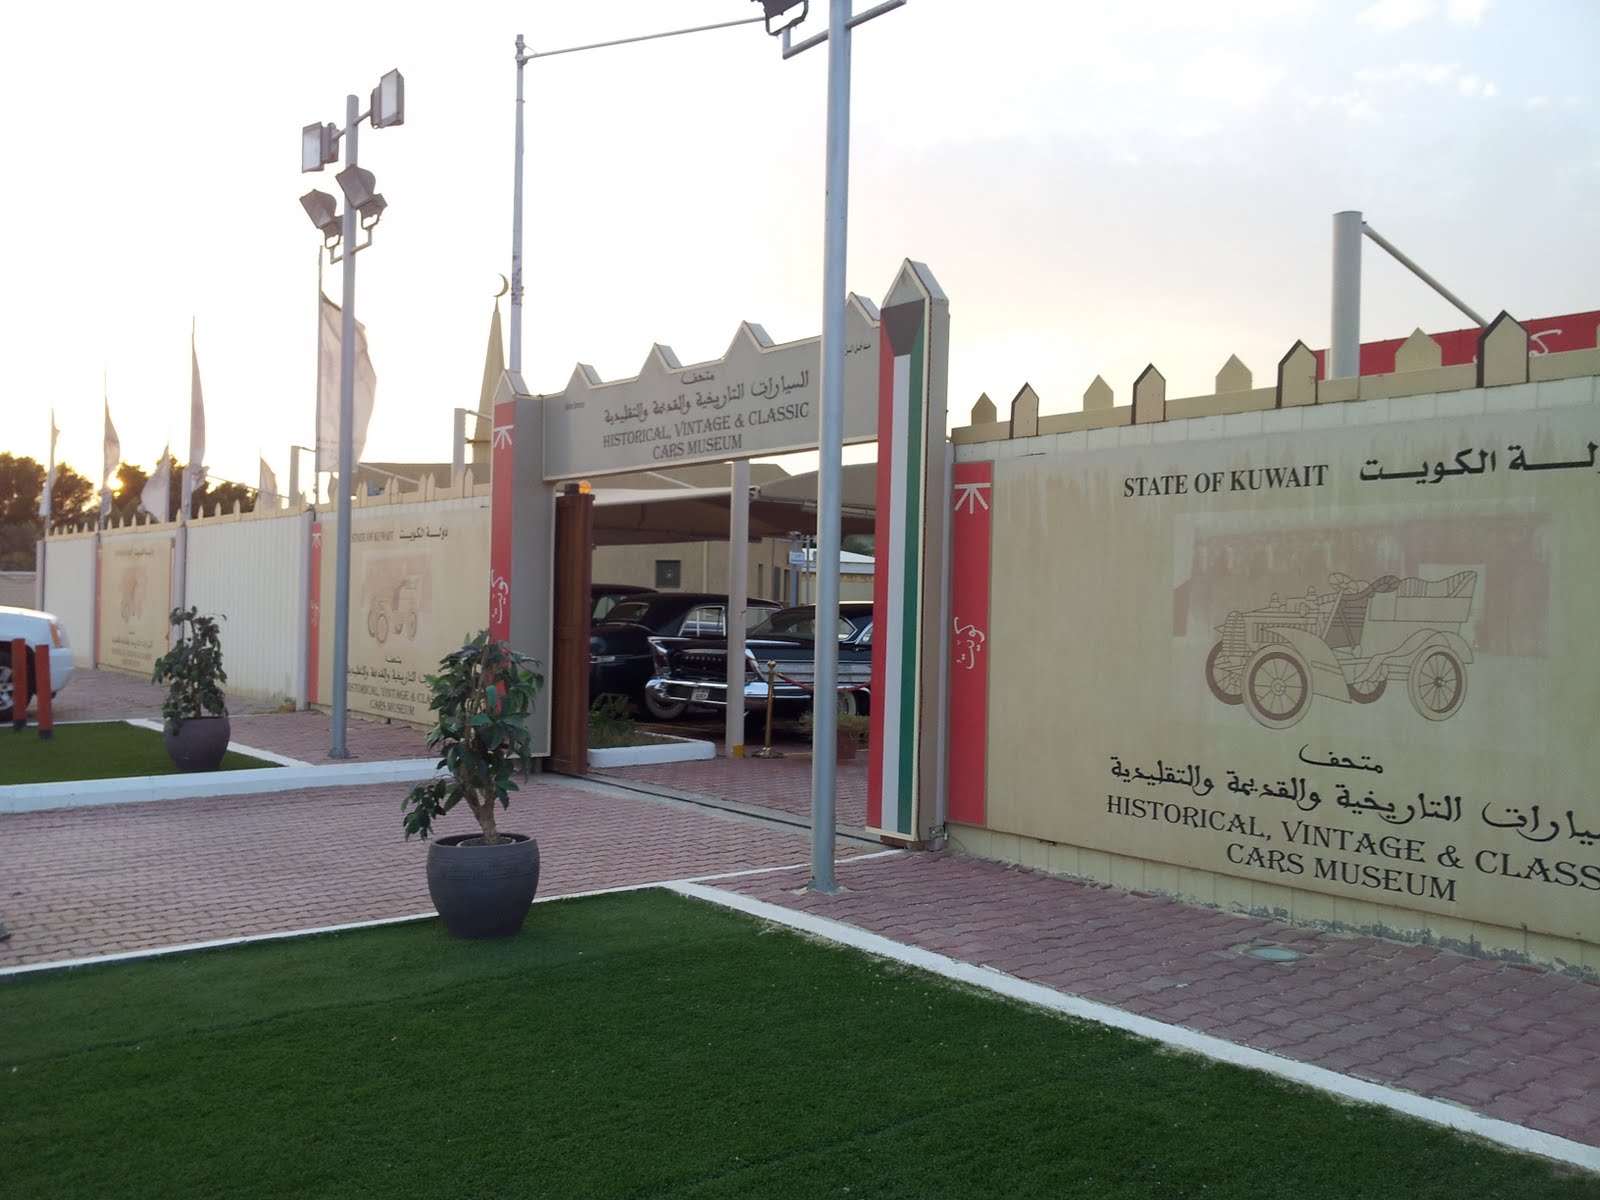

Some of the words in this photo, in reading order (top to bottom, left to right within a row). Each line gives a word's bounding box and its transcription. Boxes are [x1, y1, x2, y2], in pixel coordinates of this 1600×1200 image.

[681, 370, 715, 385] متحف
[751, 369, 809, 400] السيارات
[653, 393, 691, 415] والقديمة
[696, 382, 744, 410] التاريخية
[604, 402, 648, 426] والتقليدية
[674, 415, 731, 437] VINTAGE
[734, 412, 745, 429] &
[748, 402, 809, 426] CLASSIC
[653, 442, 684, 460] CARS
[687, 433, 742, 456] MUSEUM
[1124, 473, 1188, 497] STATE
[1194, 471, 1225, 494] OF
[1230, 464, 1329, 492] KUWAIT
[1360, 447, 1497, 484] الكويت
[1298, 743, 1384, 774] متحف
[1110, 756, 1214, 796] والتقليدية
[1226, 769, 1322, 811] والقديمة
[1336, 783, 1462, 825] التاريخية
[1106, 794, 1272, 841] HISTORICAL,
[1281, 819, 1426, 864] VINTAGE
[1437, 844, 1464, 869] &
[1227, 843, 1305, 875] CARS
[1313, 857, 1457, 902] MUSEUM
